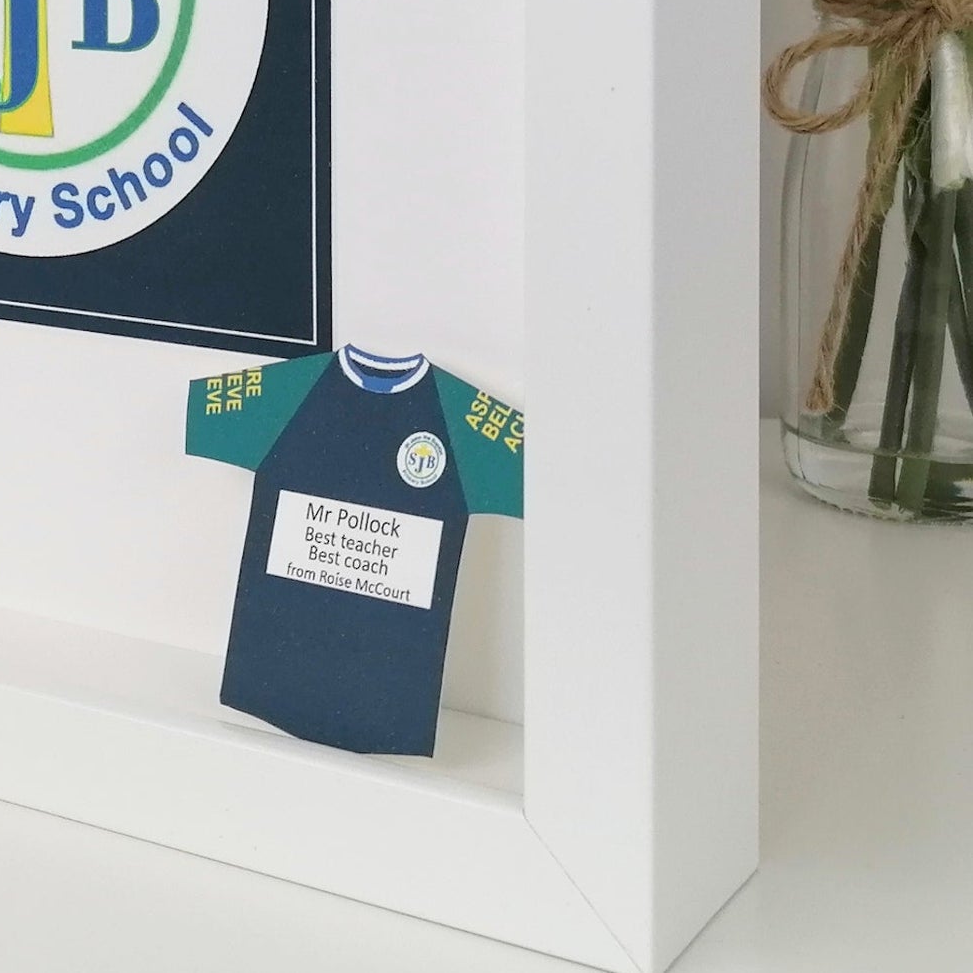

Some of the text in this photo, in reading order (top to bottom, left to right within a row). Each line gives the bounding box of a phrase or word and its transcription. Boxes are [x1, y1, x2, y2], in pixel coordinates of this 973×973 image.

[53, 102, 215, 230] School
[408, 452, 436, 473] SJB
[305, 502, 402, 538] Mr Pollock
[305, 526, 399, 560] Best teacher
[308, 545, 389, 577] Best coach
[286, 561, 316, 581] from
[354, 578, 411, 602] McCourt
